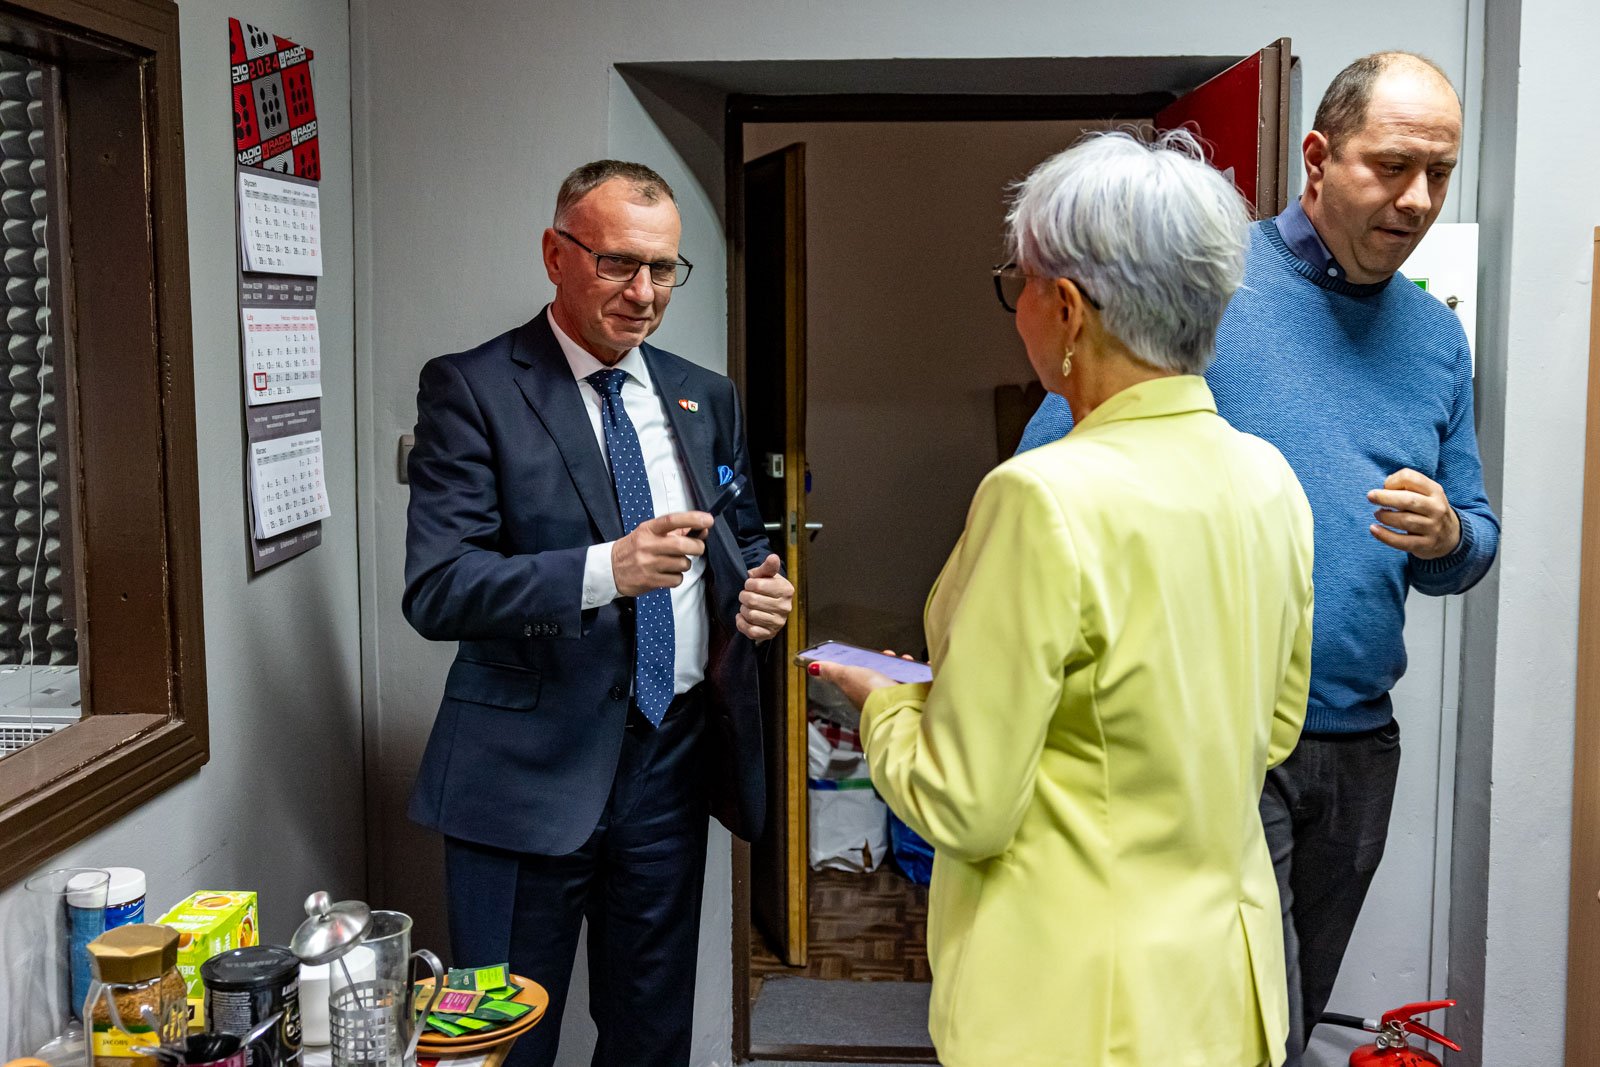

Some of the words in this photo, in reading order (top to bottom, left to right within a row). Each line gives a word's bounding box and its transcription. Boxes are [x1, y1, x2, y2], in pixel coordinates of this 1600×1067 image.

[285, 45, 306, 59] RADIO
[249, 54, 280, 78] 2024
[298, 120, 317, 136] RADIO
[268, 132, 290, 148] RADIO
